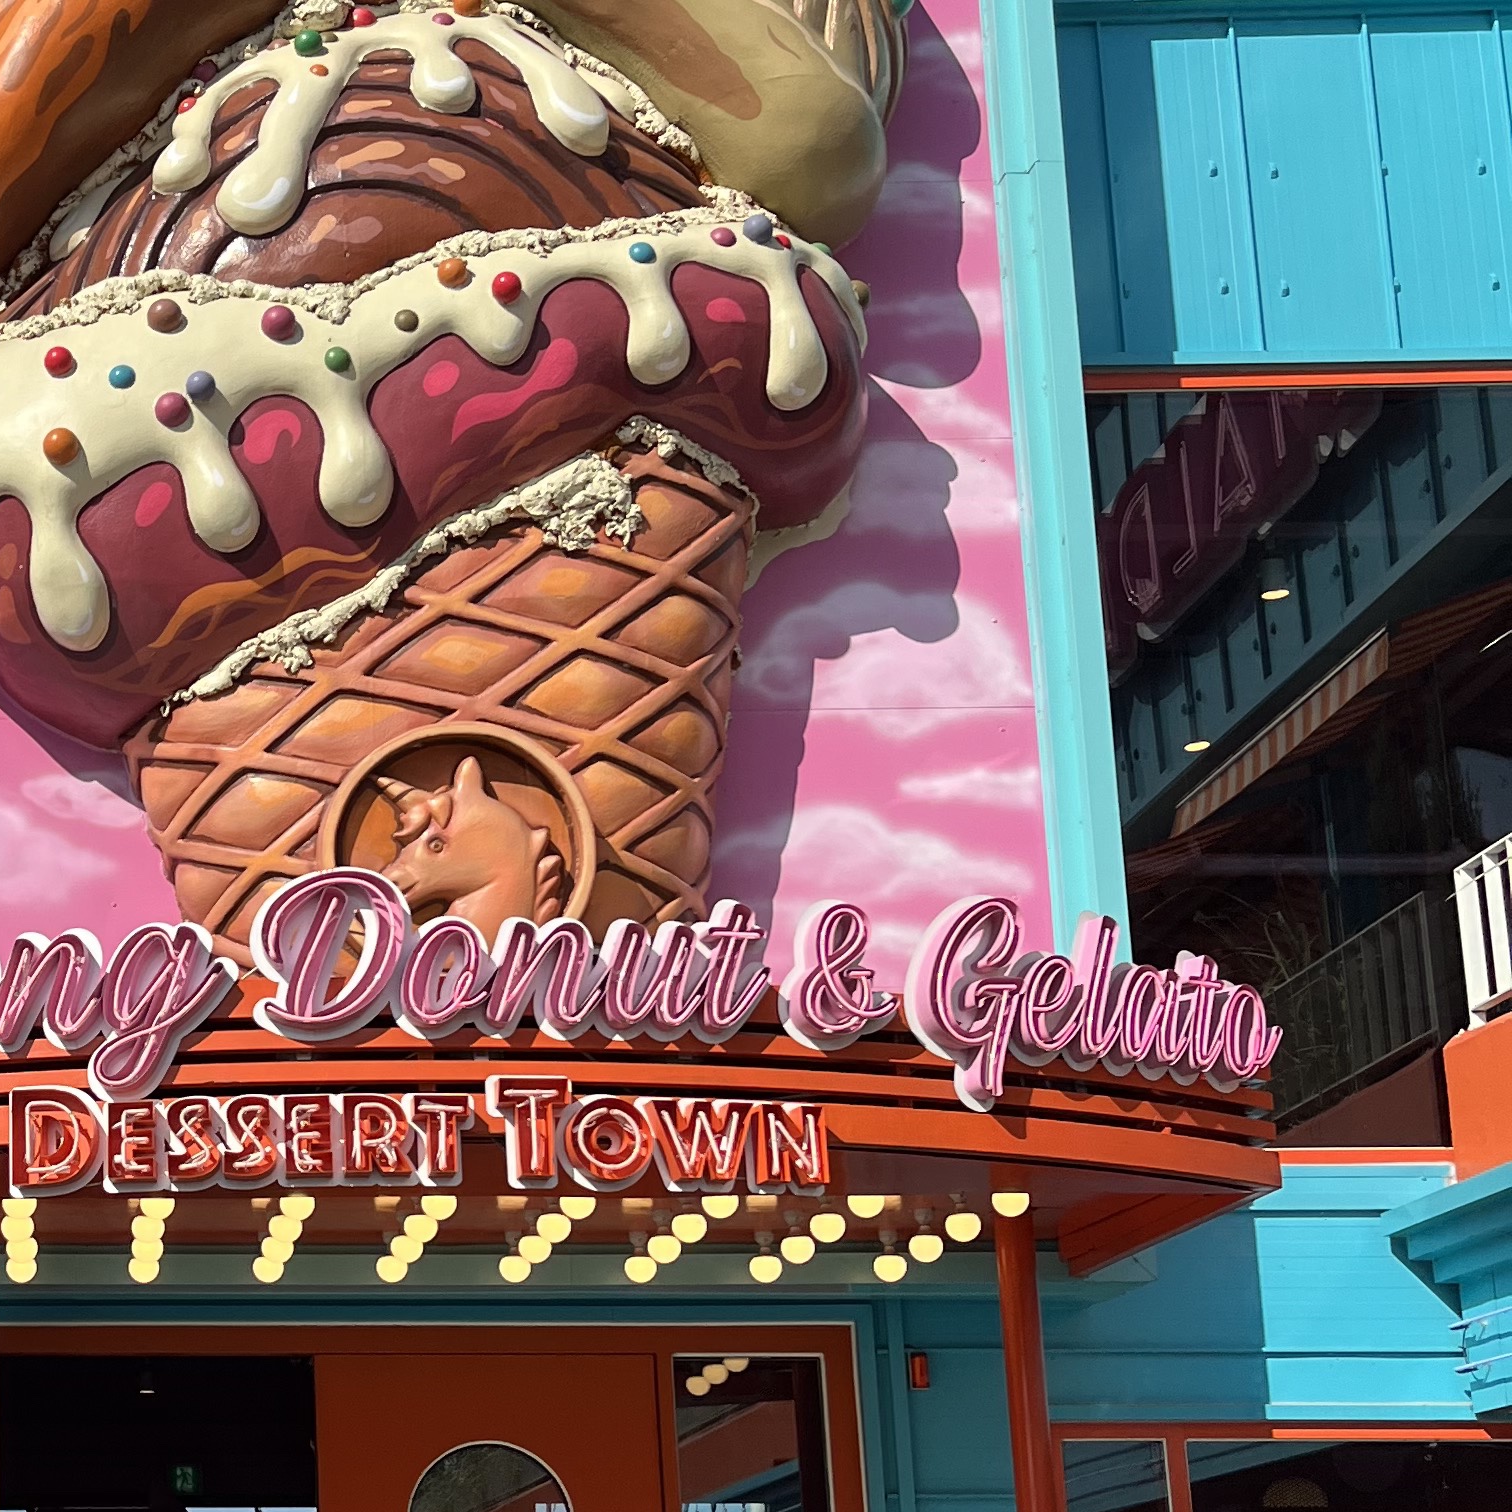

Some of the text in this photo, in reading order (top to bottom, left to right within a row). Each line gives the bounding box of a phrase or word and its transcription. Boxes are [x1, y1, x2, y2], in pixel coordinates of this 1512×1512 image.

[253, 867, 778, 1045] Donut
[779, 899, 898, 1051] &
[907, 894, 1283, 1112] Gelato
[9, 1074, 831, 1198] DESSERT TOWN
